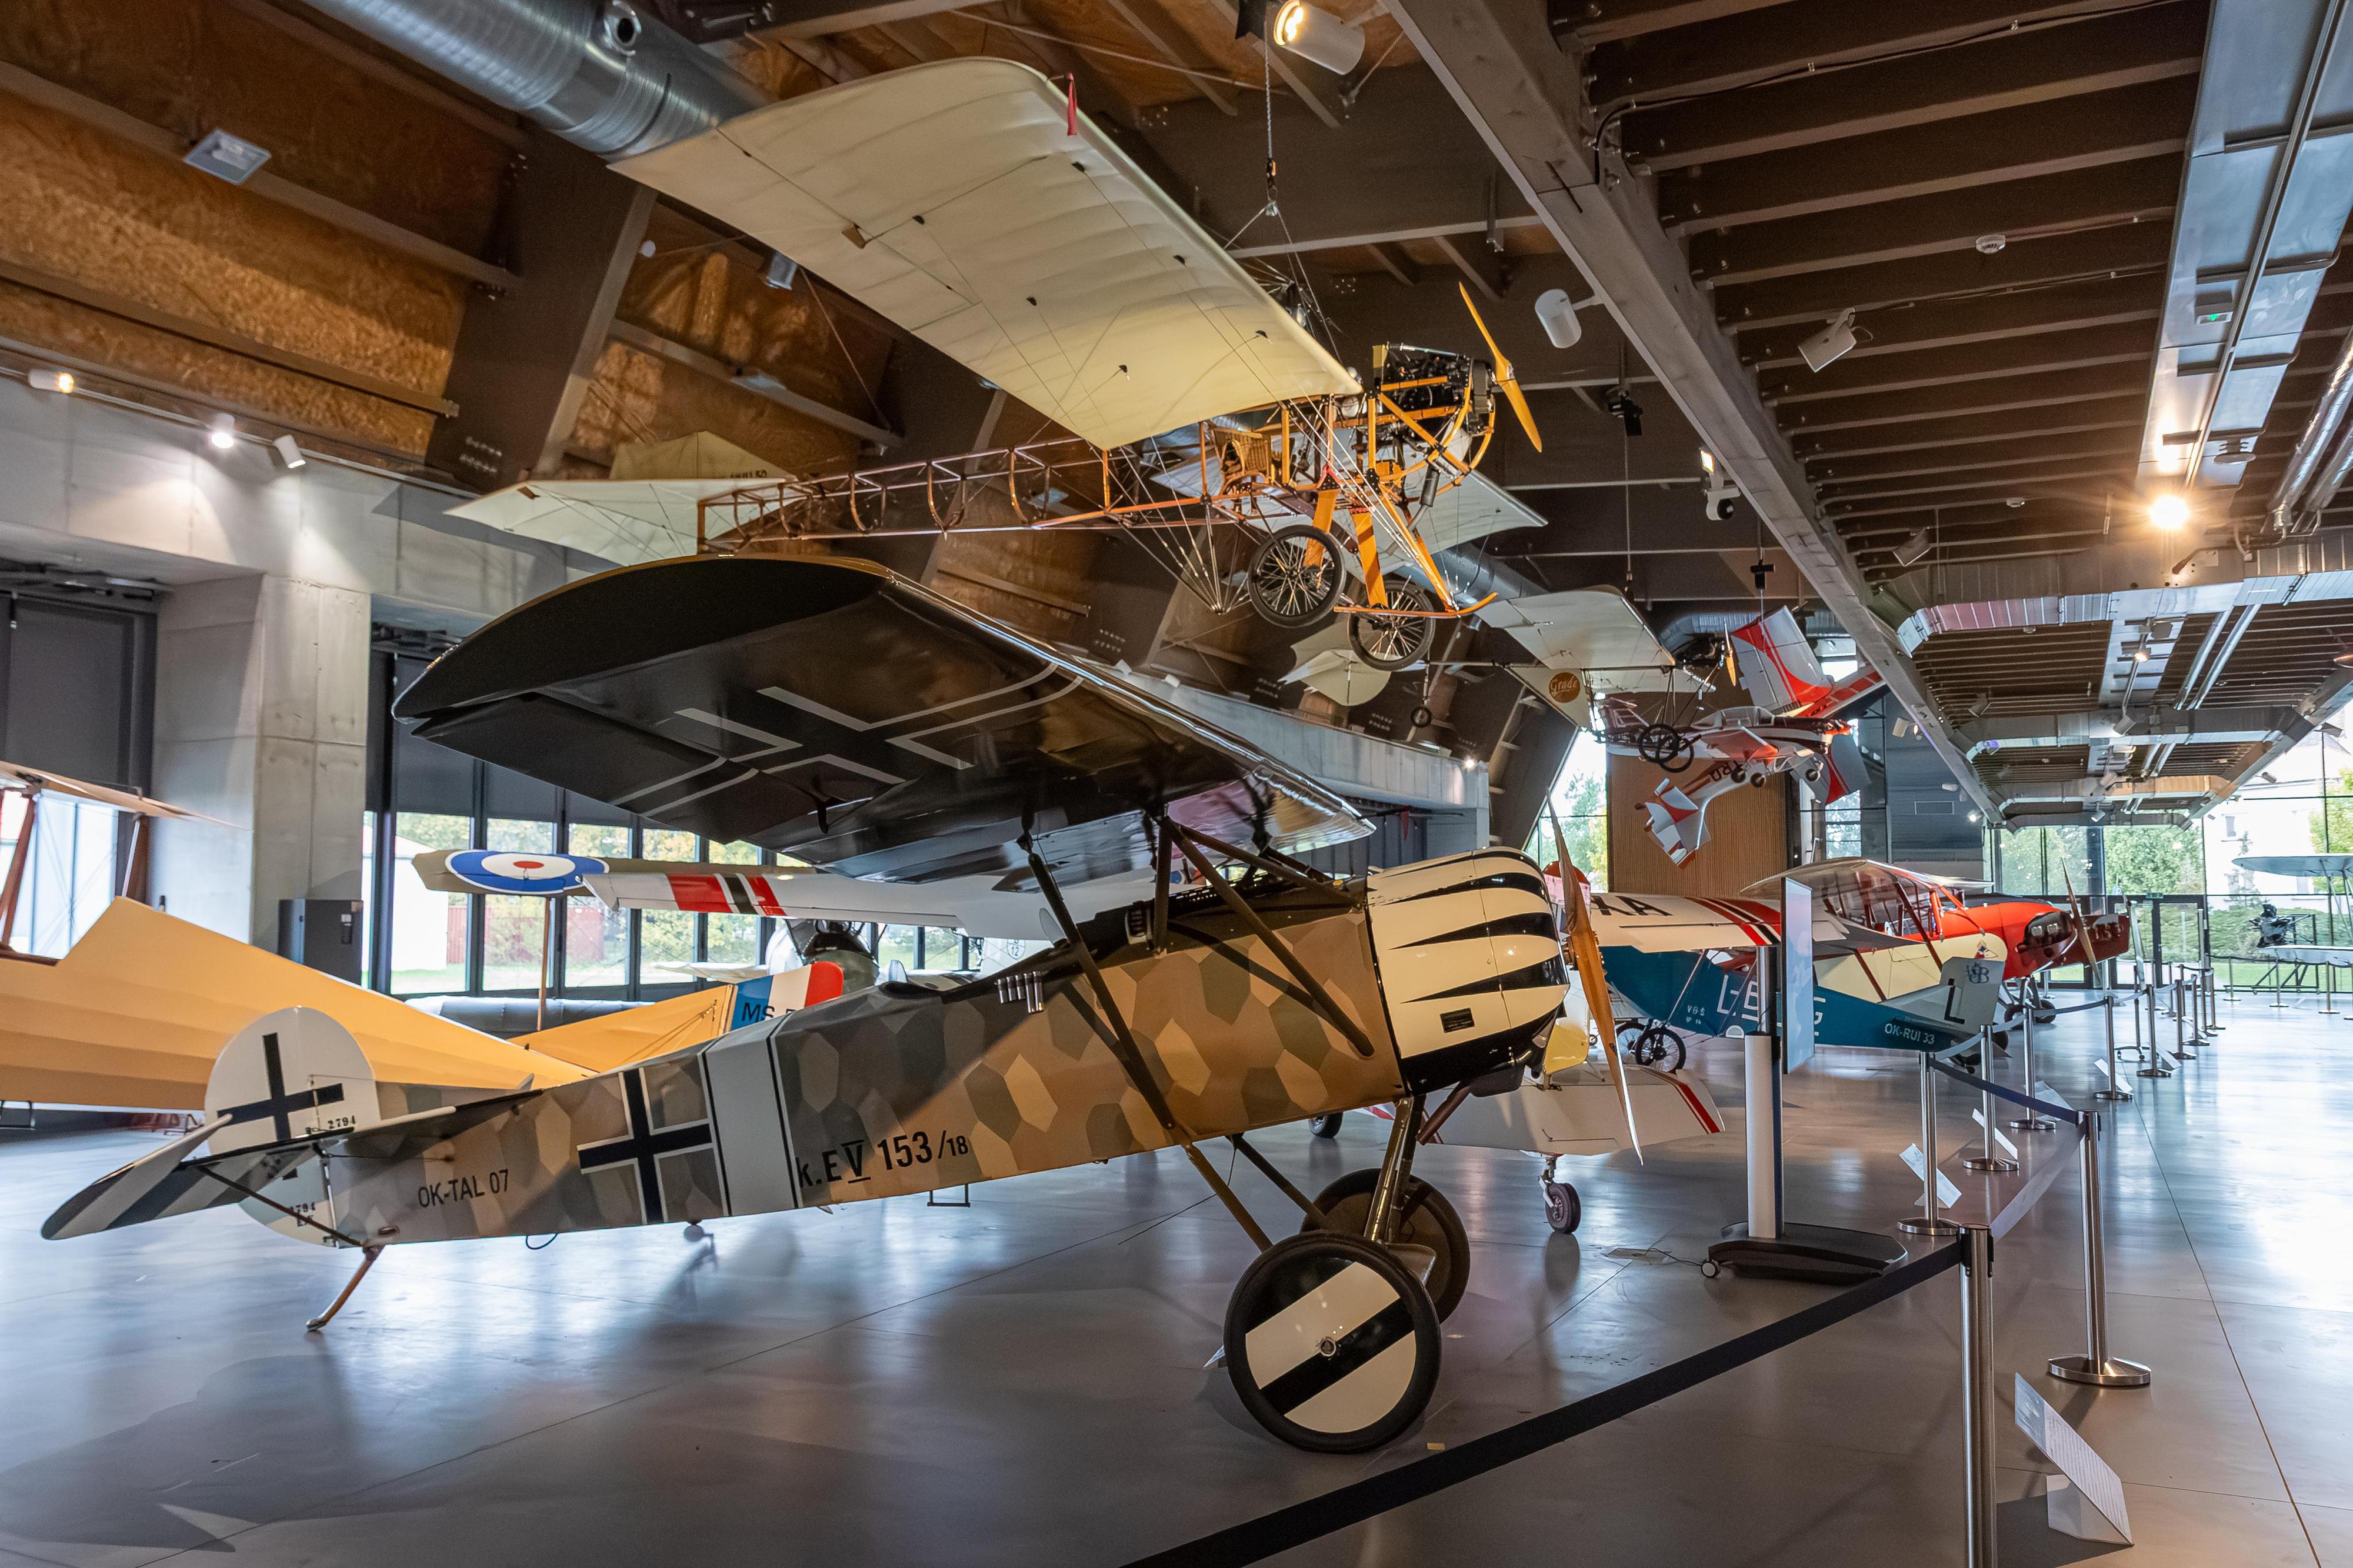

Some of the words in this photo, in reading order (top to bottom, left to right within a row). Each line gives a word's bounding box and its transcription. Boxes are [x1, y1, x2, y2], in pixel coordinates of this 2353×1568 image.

[327, 1115, 356, 1129] 2794
[418, 1175, 485, 1207] OK-TAL
[489, 1168, 508, 1194] 07
